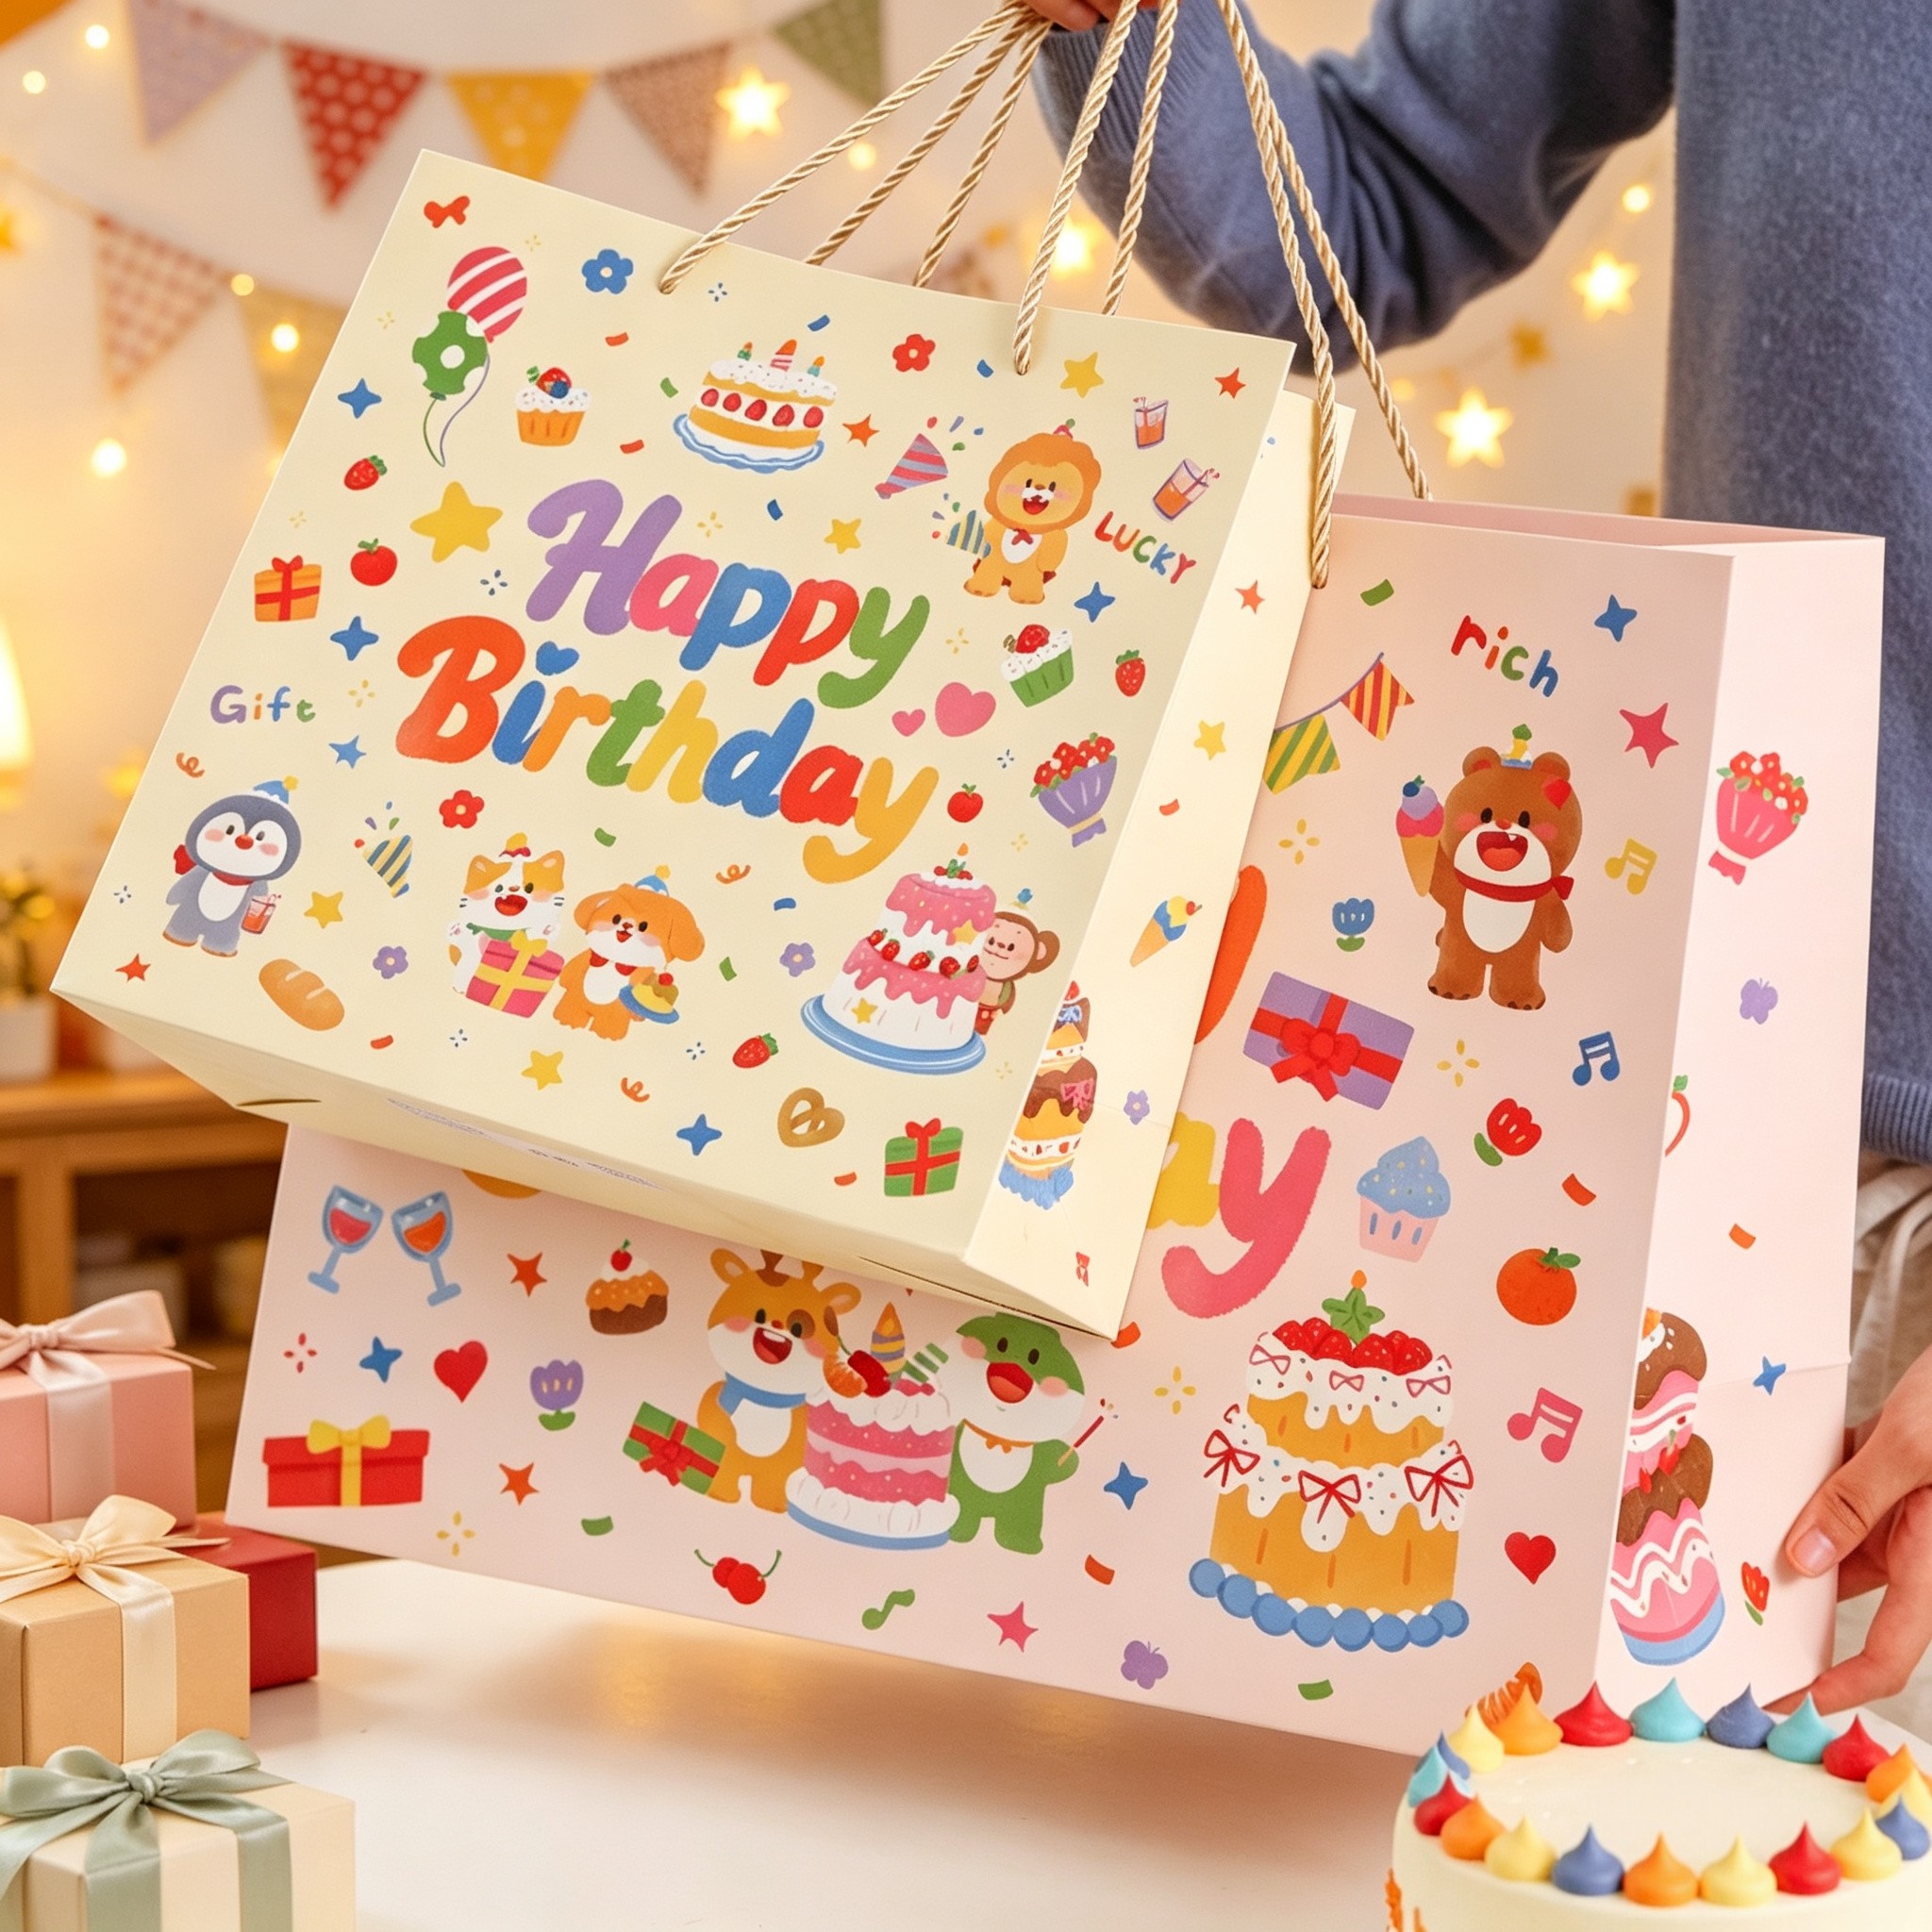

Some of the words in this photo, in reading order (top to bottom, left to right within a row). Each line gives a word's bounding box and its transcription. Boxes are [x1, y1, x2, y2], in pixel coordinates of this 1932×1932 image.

[1095, 511, 1196, 584] LUCKY
[525, 479, 930, 708] Happy
[1451, 615, 1558, 697] rich
[210, 685, 316, 724] Gift
[395, 615, 940, 884] Birthday
